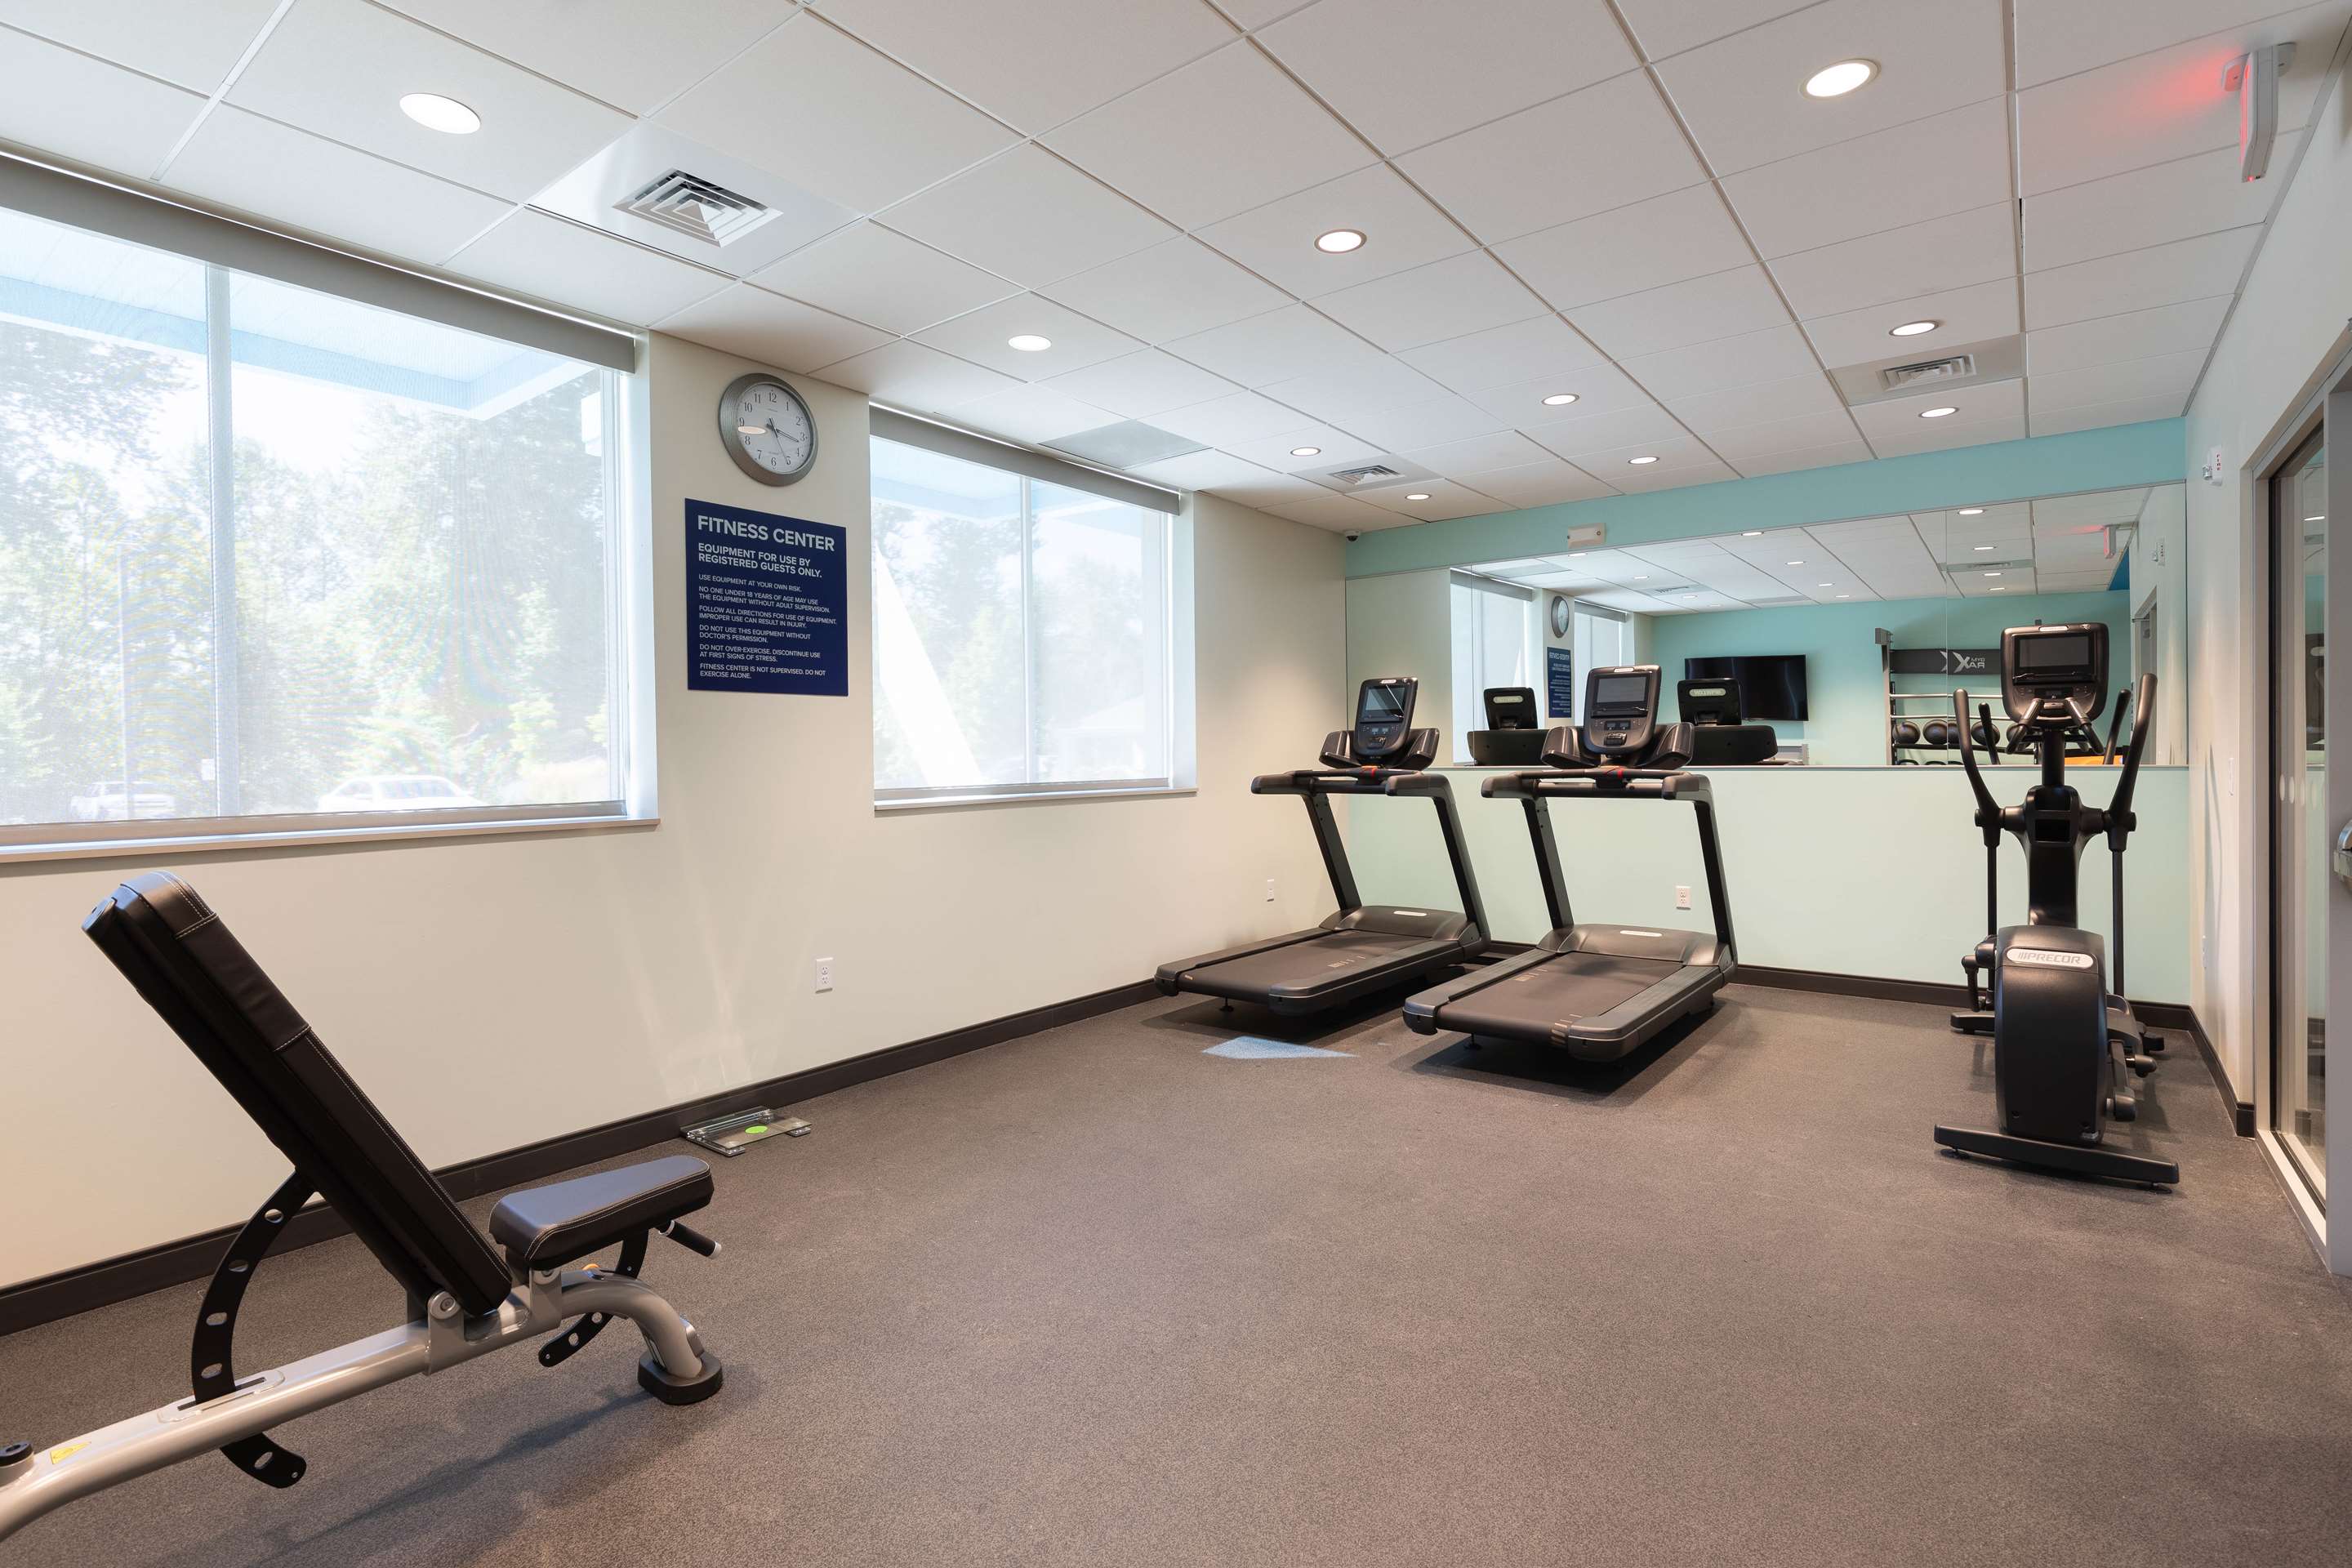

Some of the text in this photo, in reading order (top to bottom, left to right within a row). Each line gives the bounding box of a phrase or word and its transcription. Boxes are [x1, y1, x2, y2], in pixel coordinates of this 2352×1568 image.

[755, 394, 760, 403] 11
[768, 393, 777, 403] 12
[745, 402, 752, 412] 10
[786, 401, 790, 412] 1
[739, 417, 745, 426] 9
[795, 416, 801, 425] 2
[745, 435, 751, 445] 8
[800, 432, 805, 442] 3
[757, 449, 762, 459] 7
[771, 457, 777, 466] 6
[697, 514, 834, 551] FITNESS CENTER
[698, 542, 810, 567] EQUIPMENT FOR USE BY
[698, 553, 822, 577] REGISTERED GUESTS ONLY.
[712, 576, 746, 585] EQUIPMENT
[713, 595, 746, 604] EQUIPMENT
[748, 599, 774, 607] WITHOUT
[794, 604, 830, 612] SUPERVISION.
[699, 605, 724, 613] FOLLOW
[737, 609, 771, 617] DIRECTIONS
[806, 616, 836, 624] EQUIPMENT.
[699, 612, 729, 621] IMPROPER
[752, 629, 784, 637] EQUIPMENT
[733, 635, 768, 643] PERMISSION.
[725, 645, 771, 654] OVER-EXERCISE.
[2027, 952, 2081, 964] PRECOR
